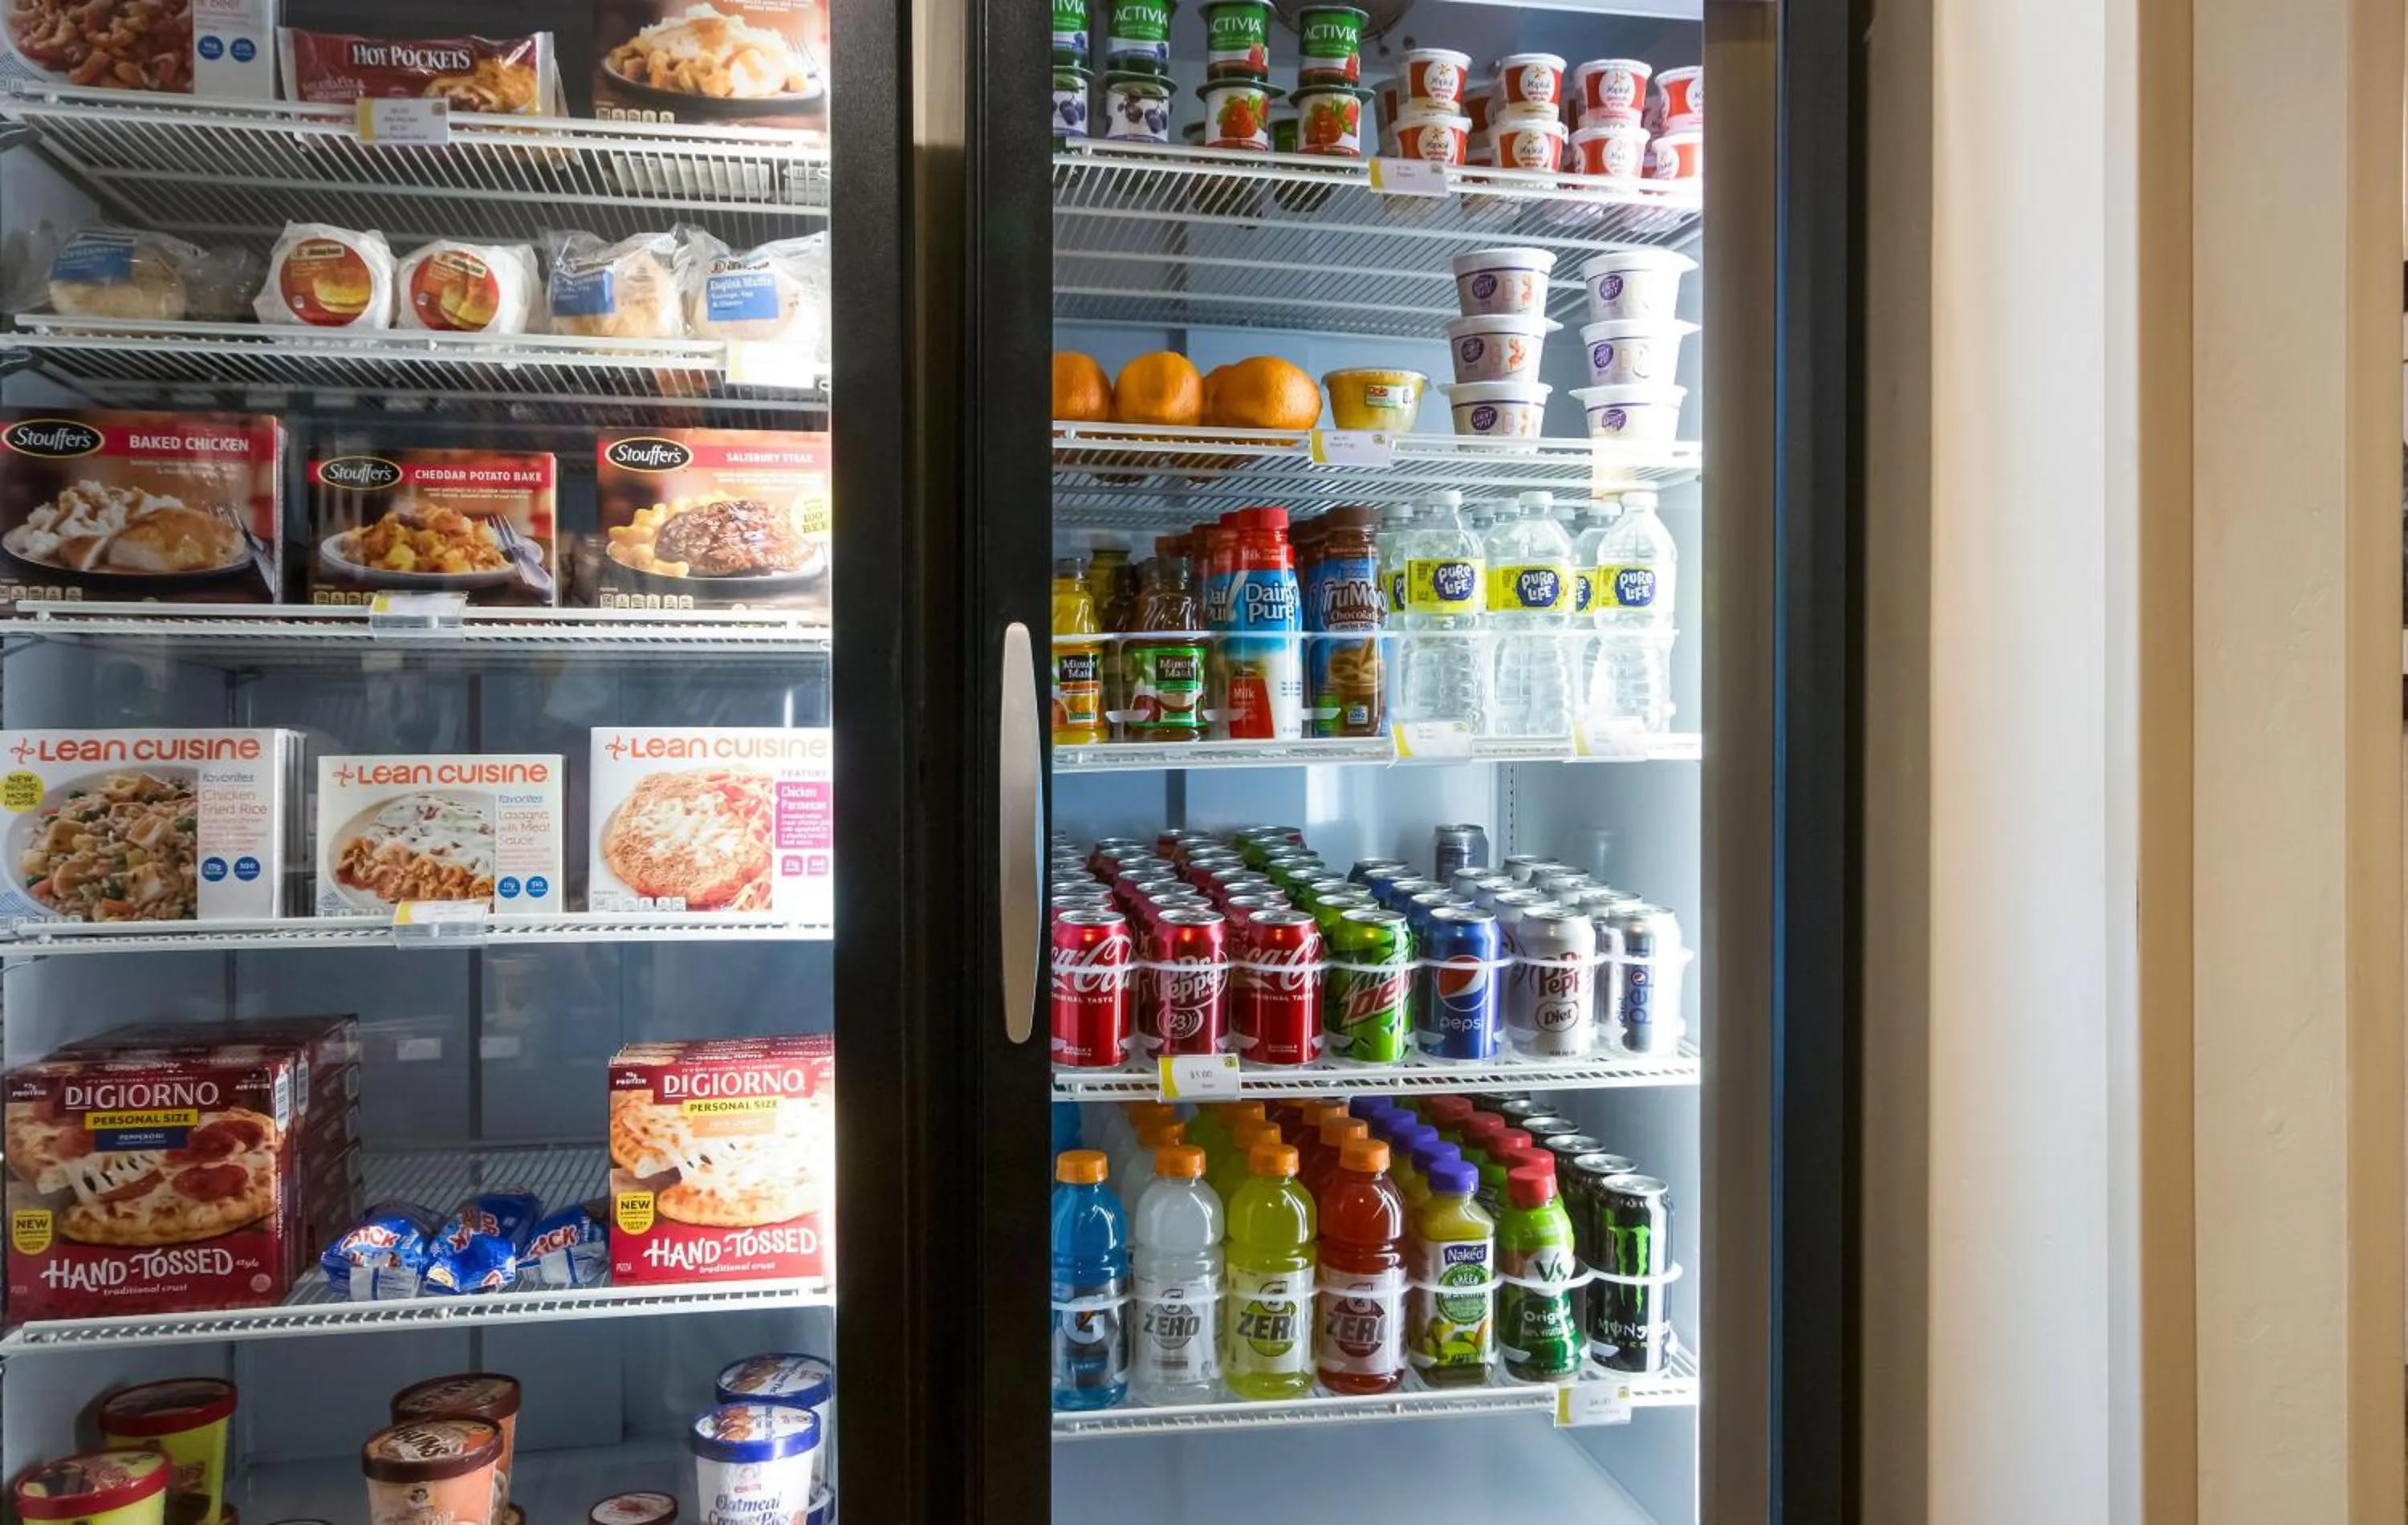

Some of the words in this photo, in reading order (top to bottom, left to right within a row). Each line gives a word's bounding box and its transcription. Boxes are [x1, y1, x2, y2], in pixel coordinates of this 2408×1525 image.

[1113, 6, 1168, 26] ACTIVIA
[1304, 25, 1357, 43] ACTIVIA
[352, 44, 387, 66] HOT
[391, 45, 471, 69] POCKETS
[15, 427, 93, 450] Stouffer's
[128, 434, 181, 450] BAKED
[185, 437, 250, 452] CHICKEN
[616, 445, 681, 466] Stouffer's
[725, 452, 779, 463] SALISBURY
[783, 453, 814, 464] STEAK
[328, 463, 393, 482] Stouffer's
[415, 470, 466, 480] CHEDDAR
[470, 470, 511, 481] POTATO
[514, 472, 543, 482] BAKE
[1438, 563, 1472, 581] PURE
[1521, 570, 1556, 588] PURE
[1619, 570, 1653, 588] PURE
[1444, 580, 1470, 595] LIFE
[1527, 584, 1552, 601] LIFE
[1625, 584, 1650, 600] LIFE
[1233, 688, 1255, 699] Milk
[40, 738, 126, 762] Lean
[133, 738, 260, 760] cuisine
[631, 737, 707, 758] Lean
[714, 736, 827, 758] cuisine
[202, 772, 255, 783] favorites
[358, 763, 432, 785] Lean
[437, 762, 549, 784] cuisine
[203, 789, 256, 801] Chicken
[498, 793, 543, 803] favorites
[202, 803, 235, 815] Fried
[240, 803, 267, 815] Rice
[498, 809, 550, 823] Lasagna
[498, 836, 535, 846] Sauce
[1168, 1014, 1186, 1031] 23
[1544, 1009, 1572, 1026] Diet
[664, 1068, 805, 1097] DIGIORNO
[65, 1081, 218, 1109] DIGIORNO
[689, 1100, 752, 1112] PERSONAL
[755, 1099, 778, 1109] SIZE
[92, 1115, 160, 1124] PERSONAL
[163, 1113, 191, 1123] SIZE
[620, 1200, 651, 1210] NEW
[16, 1219, 48, 1229] NEW
[642, 1227, 817, 1271] HAND-TOSSED
[1448, 1246, 1485, 1262] Naked
[41, 1248, 234, 1292] HAND-TOSSED
[700, 1262, 750, 1273] traditional
[103, 1285, 160, 1297] traditional
[161, 1282, 188, 1294] crust
[1143, 1312, 1202, 1337] ZERO
[715, 1490, 782, 1512] Oatmeal
